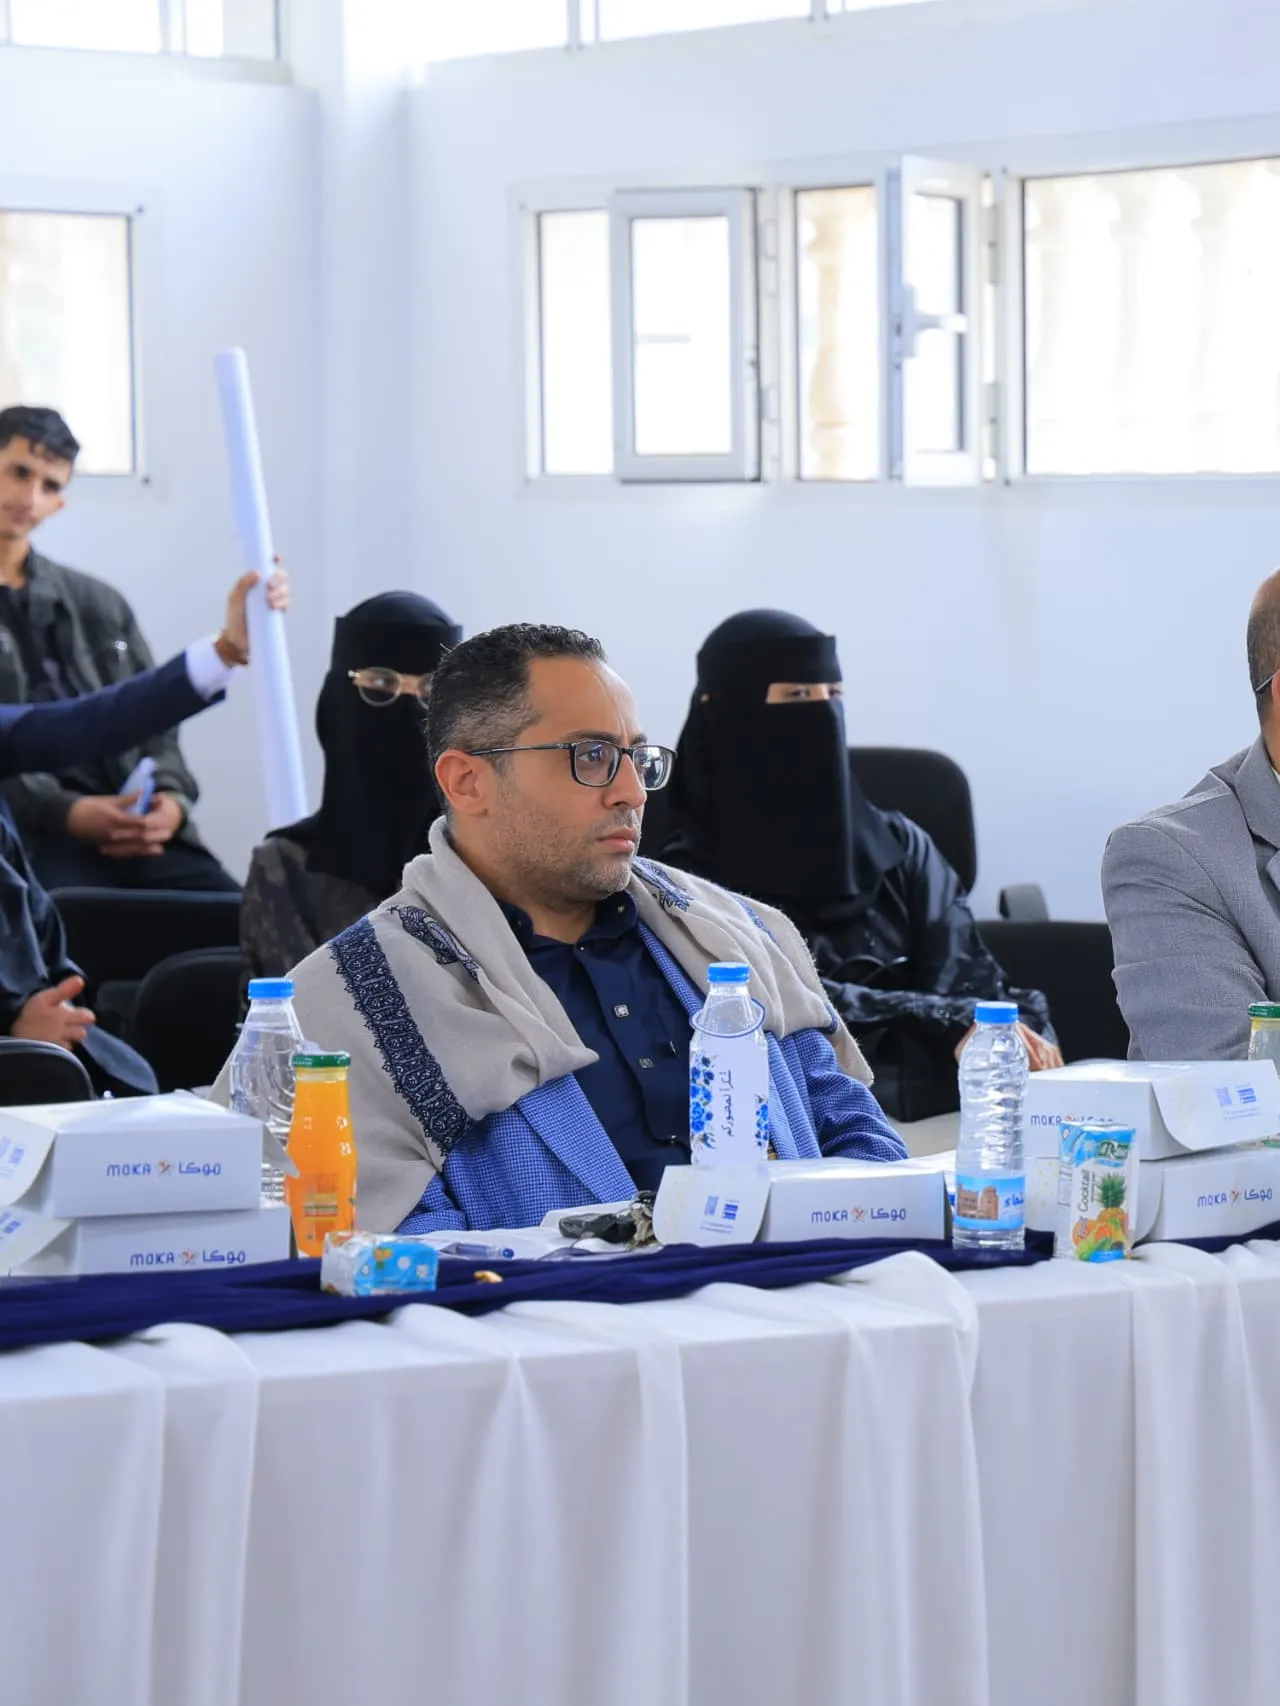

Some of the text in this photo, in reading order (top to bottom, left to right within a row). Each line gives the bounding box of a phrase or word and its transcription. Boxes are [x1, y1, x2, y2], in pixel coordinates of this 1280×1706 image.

[106, 1163, 151, 1177] MOKA
[178, 1161, 222, 1176] موكا
[1077, 1168, 1091, 1213] Cocktail
[1244, 1188, 1273, 1201] موكا
[1197, 1193, 1227, 1208] MOKA
[810, 1209, 848, 1223] MOKA
[870, 1207, 907, 1222] موكا
[130, 1251, 175, 1266] MOKA
[202, 1249, 246, 1264] موكا
